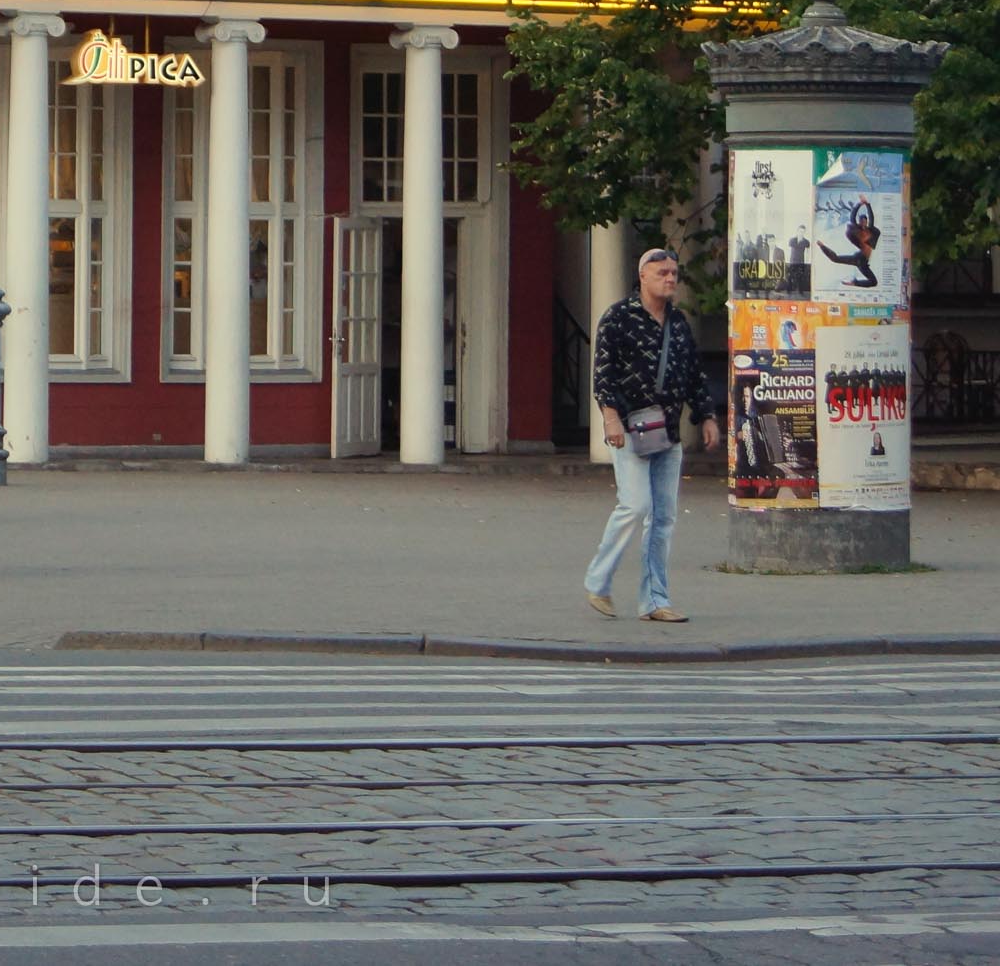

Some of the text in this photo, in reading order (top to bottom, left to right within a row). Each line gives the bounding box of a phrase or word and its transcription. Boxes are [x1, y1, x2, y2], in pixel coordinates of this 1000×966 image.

[130, 57, 201, 81] PICA
[760, 372, 814, 387] RICHARD
[753, 385, 815, 401] GALLIANO
